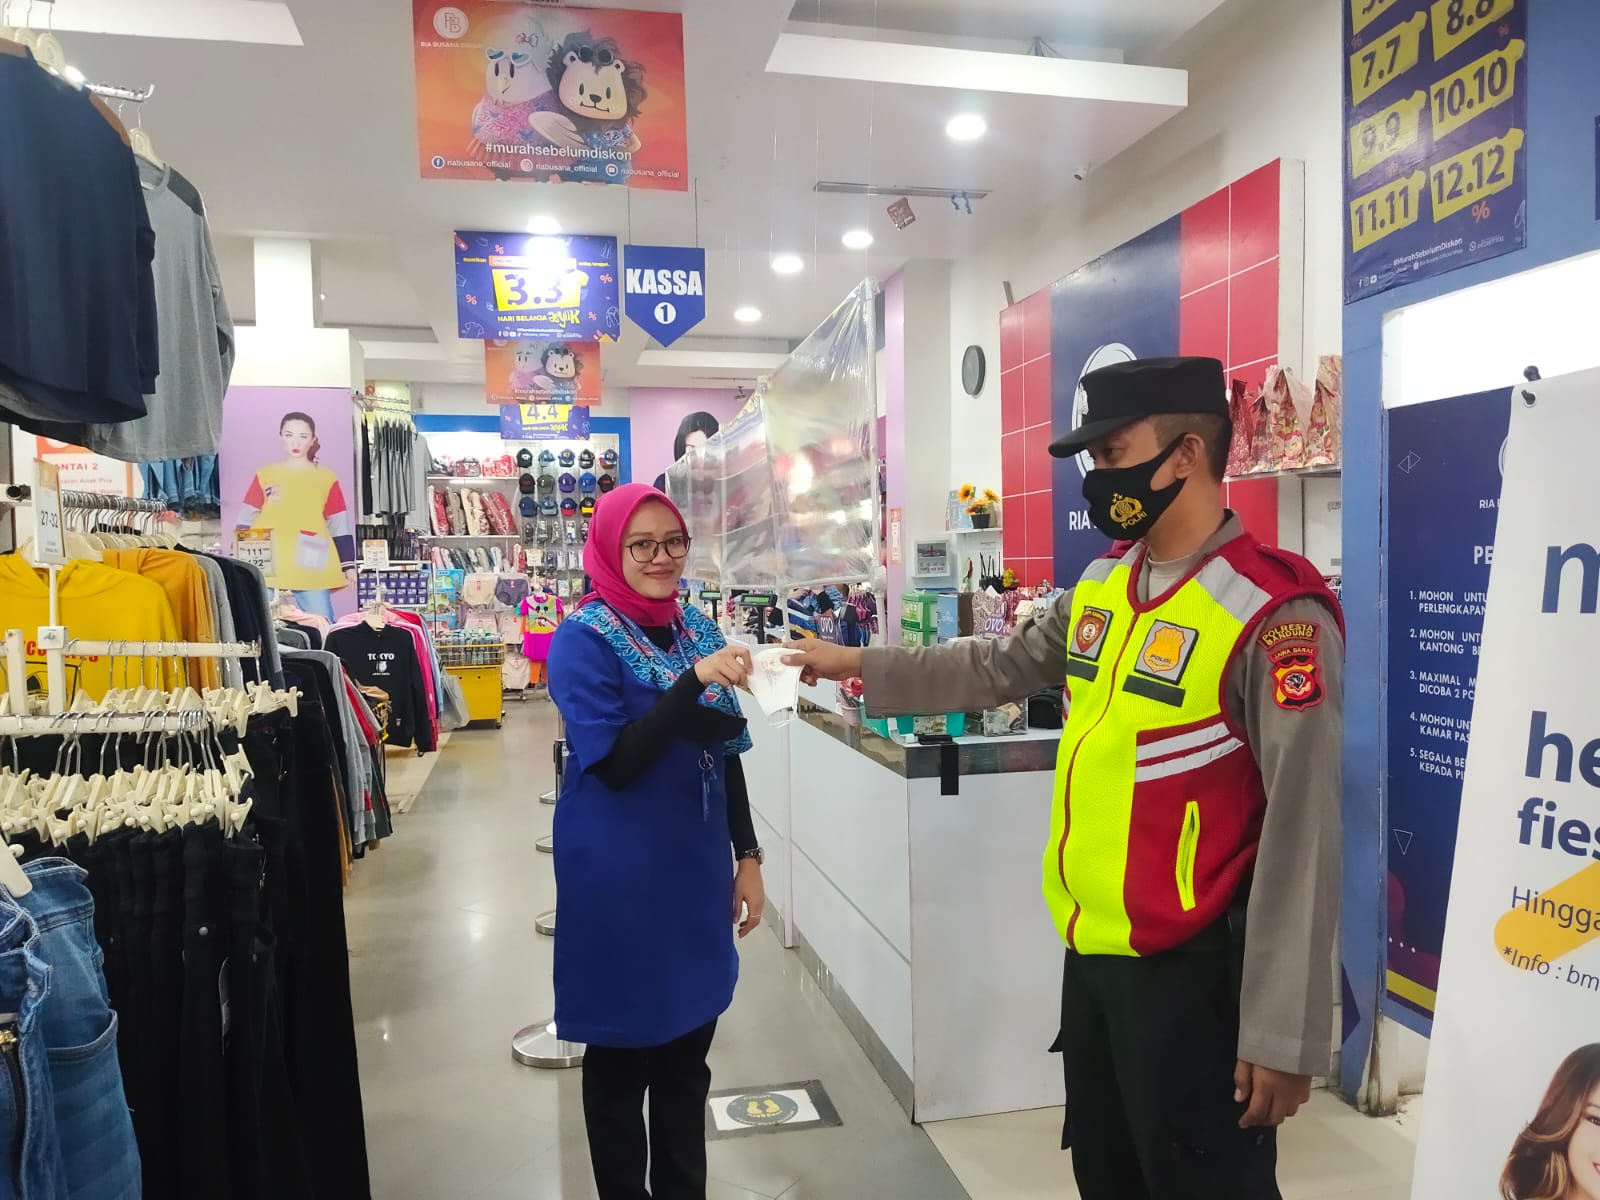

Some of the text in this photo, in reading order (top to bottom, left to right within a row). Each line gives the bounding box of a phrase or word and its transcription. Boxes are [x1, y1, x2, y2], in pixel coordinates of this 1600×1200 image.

[1362, 35, 1400, 88] 7.7
[1433, 57, 1507, 123] 10.10
[1362, 111, 1400, 158] 9.9
[485, 141, 632, 161] #murahsebelumdiskon
[1432, 144, 1505, 205] 12.12
[1354, 185, 1409, 236] 11.11
[504, 273, 563, 306] 3.3
[626, 268, 703, 296] KASSA
[660, 305, 670, 323] 1
[1479, 499, 1495, 508] RIA
[1069, 510, 1091, 531] RIA
[1121, 511, 1147, 529] POLRI
[1410, 590, 1417, 600] 1.
[1419, 591, 1453, 601] MOHON
[984, 617, 1004, 632] OVO
[1262, 623, 1314, 642] POLRESTA
[1265, 630, 1313, 646] BANDUNG
[1410, 629, 1417, 638] 2.
[1419, 629, 1454, 641] MOHON
[1419, 641, 1464, 654] KANTONG
[1410, 671, 1417, 680] 3.
[1419, 671, 1461, 686] MAXIMAL
[1419, 683, 1452, 697] DICOBA
[1454, 689, 1460, 698] 2
[1410, 712, 1417, 721] 4.
[1419, 713, 1454, 726] MOHON
[1420, 725, 1452, 740] KAMAR
[1410, 748, 1417, 757] 5.
[1419, 749, 1452, 765] SEGALA
[1419, 762, 1453, 778] KEPADA
